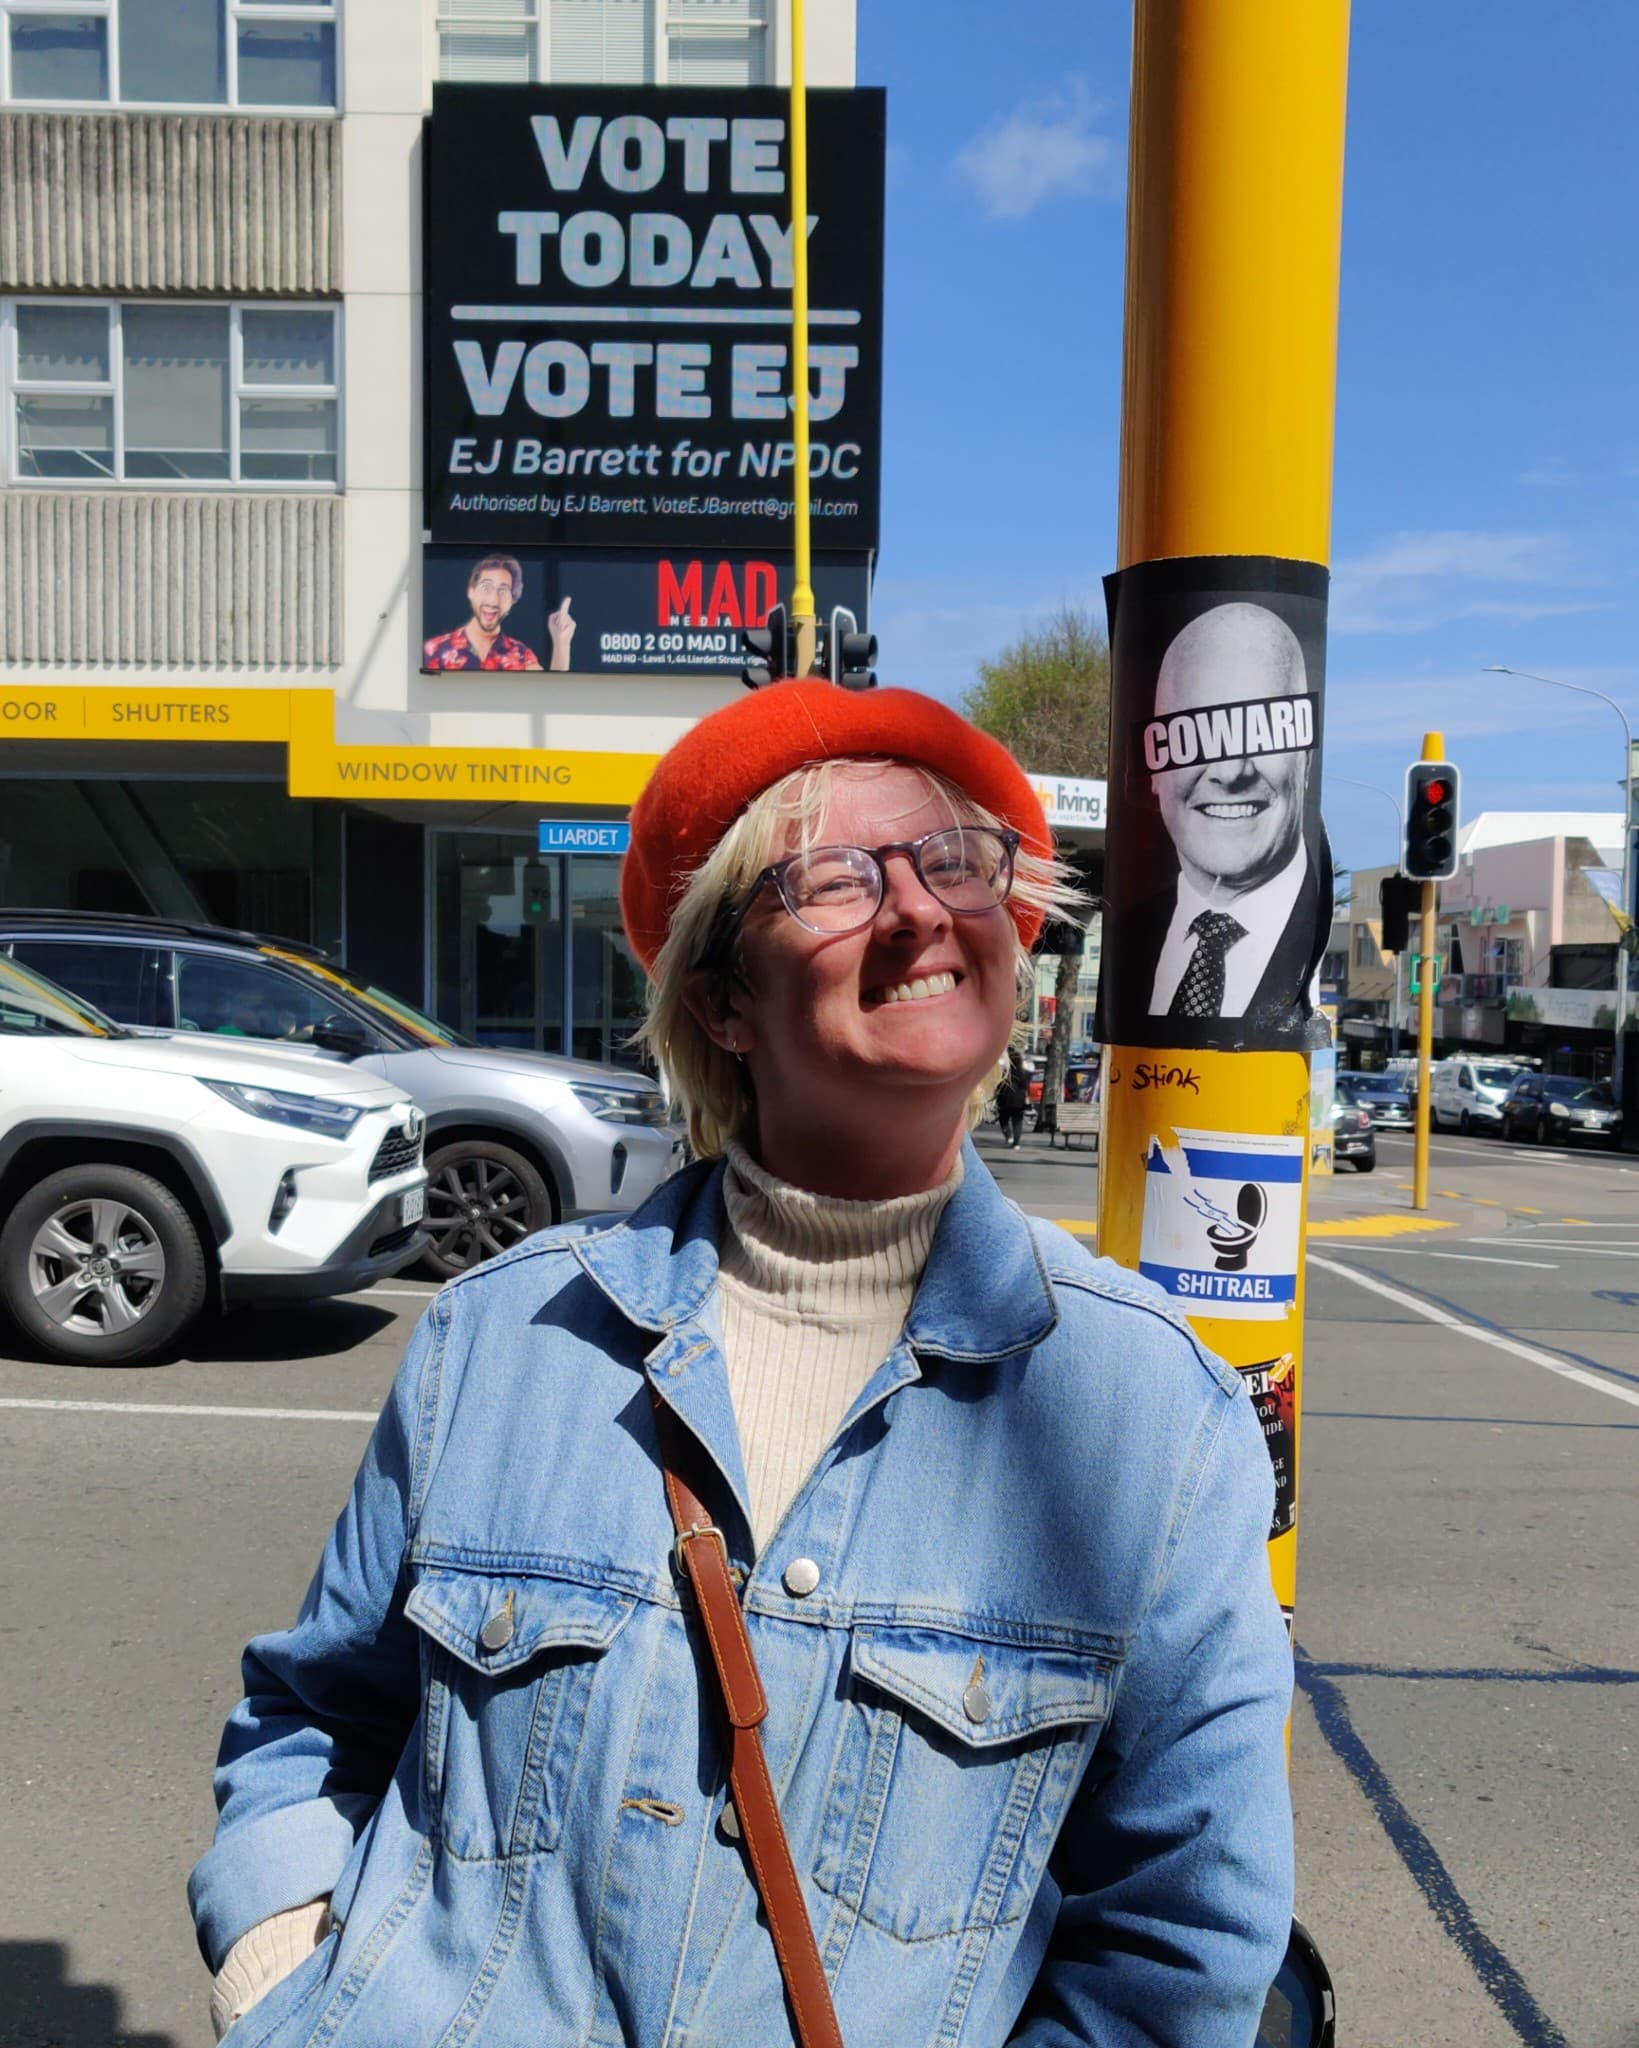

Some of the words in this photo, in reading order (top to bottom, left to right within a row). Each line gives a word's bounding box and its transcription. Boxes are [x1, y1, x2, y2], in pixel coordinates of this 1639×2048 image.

[529, 115, 785, 193] VOTE
[497, 210, 820, 288] TODAY
[452, 340, 712, 418] VOTE
[731, 344, 859, 421] EJ
[448, 438, 503, 474] EJ
[513, 439, 661, 476] Barrett
[671, 441, 730, 478] for
[450, 493, 538, 511] Authorised
[540, 494, 561, 517] by
[564, 495, 586, 512] EJ
[588, 495, 648, 515] Barrett,
[657, 560, 777, 627] MAD
[669, 615, 732, 626] MEDIA
[600, 633, 641, 651] 0800
[644, 634, 655, 651] 2
[658, 634, 684, 652] GO
[687, 635, 727, 652] MAD
[2, 701, 57, 721] OOR
[112, 703, 230, 723] SHUTTERS
[1143, 699, 1313, 770] COWARD
[337, 762, 457, 782] WINDOW
[466, 764, 572, 785] TINTING
[1057, 784, 1100, 821] living
[549, 828, 619, 846] LIARDET
[1132, 1063, 1200, 1095] Stink
[1176, 1272, 1274, 1299] SHITRAEL
